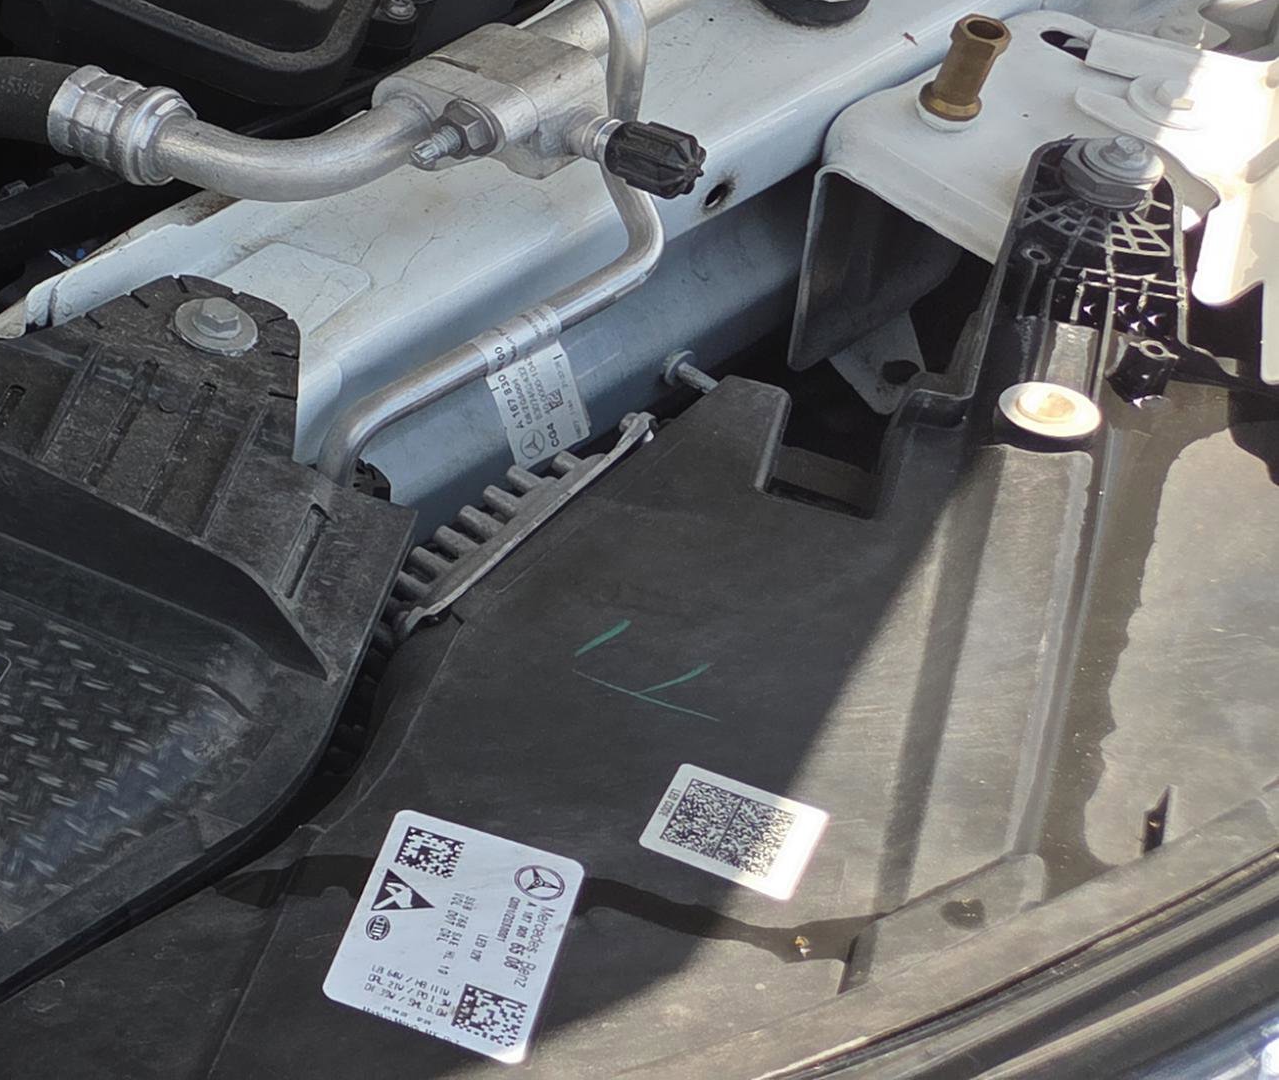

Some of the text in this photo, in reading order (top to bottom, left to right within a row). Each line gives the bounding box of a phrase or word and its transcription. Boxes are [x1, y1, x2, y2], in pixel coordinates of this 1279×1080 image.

[498, 374, 513, 396] 830
[507, 399, 520, 418] 167
[516, 420, 525, 428] A
[444, 909, 458, 926] DOT
[522, 912, 534, 924] 167
[526, 907, 556, 953] Mercedes
[475, 934, 489, 948] LED
[509, 943, 525, 956] 65
[504, 956, 520, 969] 08
[514, 961, 536, 988] Benz
